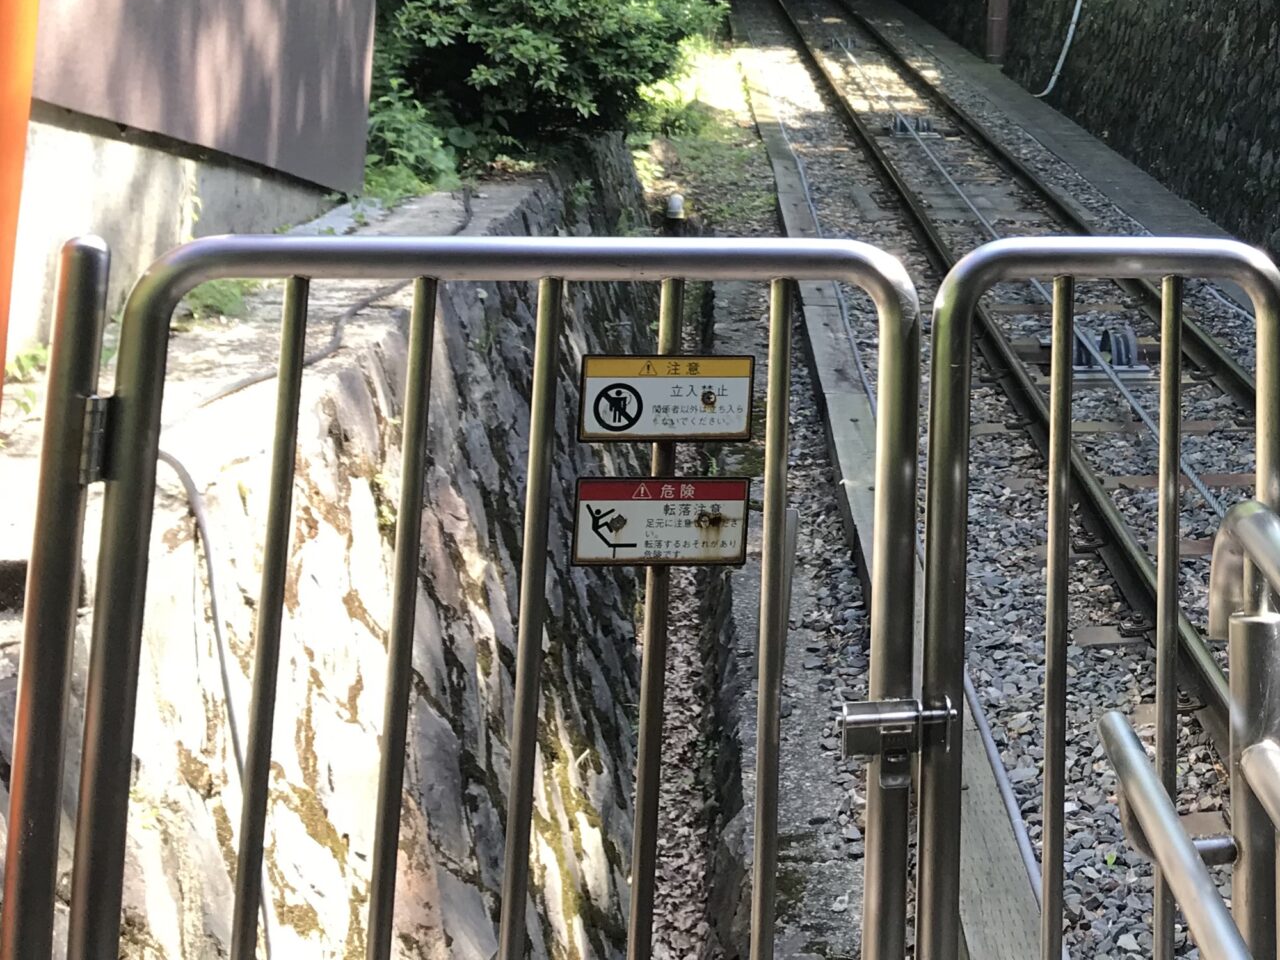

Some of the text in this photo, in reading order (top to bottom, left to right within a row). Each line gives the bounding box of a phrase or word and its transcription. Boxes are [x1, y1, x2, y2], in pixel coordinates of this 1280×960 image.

[666, 361, 701, 376] 注意
[670, 384, 729, 397] 立入止
[660, 484, 696, 499] 危険
[663, 503, 722, 516] 転落注意
[645, 539, 737, 549] 転落するおそれがあり
